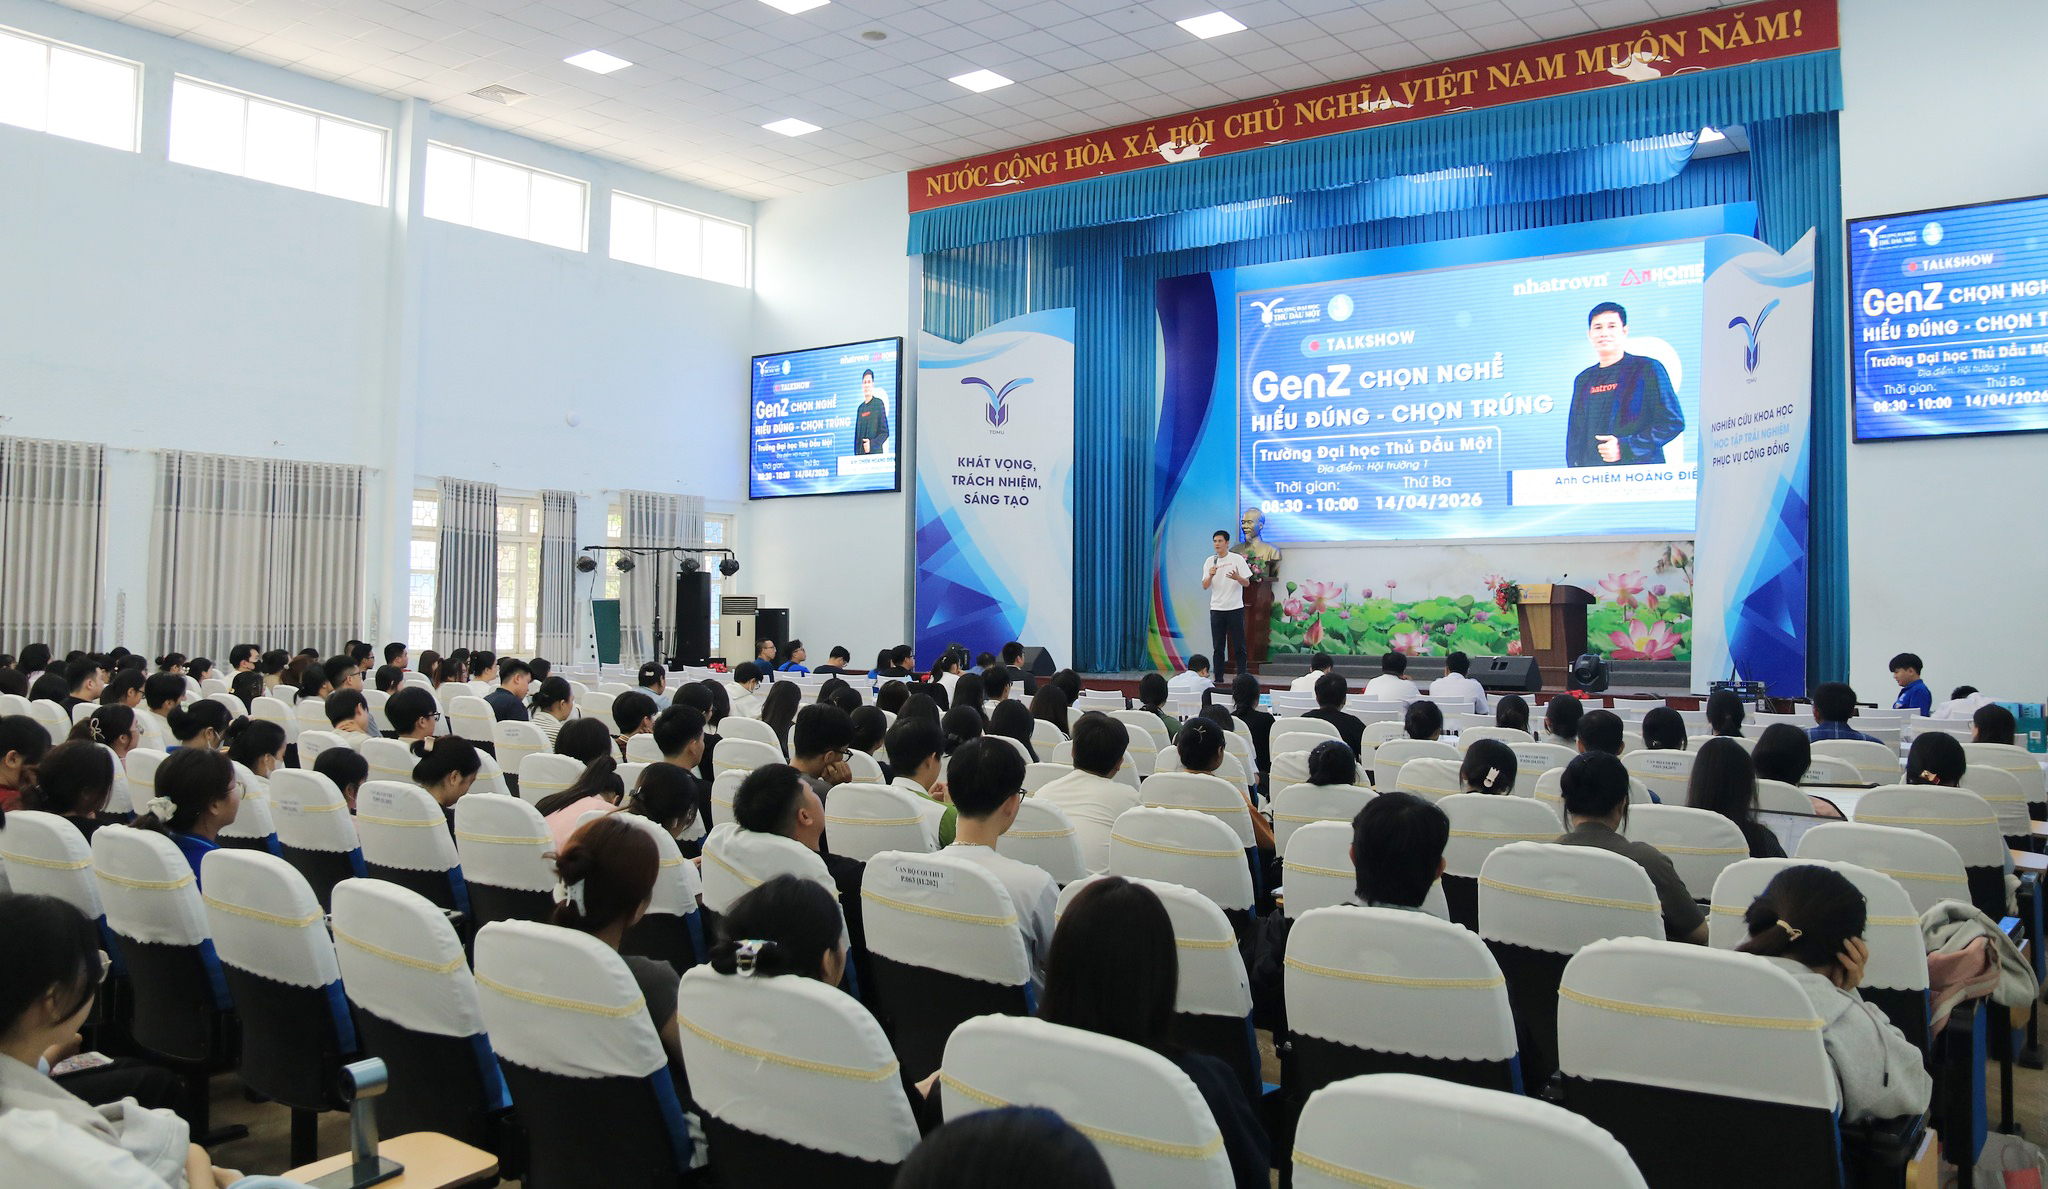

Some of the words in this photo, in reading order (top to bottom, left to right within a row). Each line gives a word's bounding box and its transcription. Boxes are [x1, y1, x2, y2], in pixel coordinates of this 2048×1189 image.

[926, 164, 988, 196] NƯỚC
[993, 151, 1058, 185] CỘNG
[1064, 140, 1116, 170] HÒA
[1123, 126, 1160, 156] XÃ
[1168, 116, 1215, 149] HỘI
[1224, 98, 1286, 139] CHỦ
[1294, 84, 1392, 126] NGHĨA
[1400, 67, 1479, 106] VIỆT
[1487, 52, 1567, 89] NAM
[1575, 28, 1687, 76] MUÔN
[1698, 9, 1804, 54] NĂM!
[1922, 253, 1994, 271] TALKSHOW
[1512, 273, 1609, 296] nhatrovn
[1862, 281, 1944, 317] GenZ
[1949, 283, 2005, 305] CHỌN
[1863, 318, 1901, 342] HIỂU
[1907, 318, 1959, 338] ĐÚNG
[1975, 313, 2033, 334] CHỌN
[1327, 330, 1415, 351] TALKSHOW
[1870, 354, 1914, 368] Trường
[1917, 352, 1940, 365] Đại
[1943, 350, 1968, 365] học
[1971, 346, 1995, 360] Thủ
[1999, 342, 2027, 358] Dầu
[2030, 343, 2048, 357] Mộ
[780, 381, 811, 392] TALKSHOW
[1252, 364, 1351, 403] GenZ
[1359, 366, 1429, 391] CHỌN
[1437, 351, 1504, 383] NGHỀ
[1986, 375, 2007, 388] Thứ
[2009, 376, 2026, 387] Ba
[1883, 382, 1907, 395] Thời
[1909, 382, 1936, 396] gian:
[1873, 399, 1908, 413] 08:30
[1918, 396, 1952, 410] 10:00
[1965, 390, 2048, 408] 14/04/2026
[755, 398, 789, 420] GenZ
[790, 400, 814, 415] CHỌN
[1251, 404, 1298, 432] HIỂU
[1305, 405, 1371, 429] ĐÚNG
[1391, 401, 1463, 426] CHỌN
[1470, 391, 1555, 418] TRÚNG
[1711, 417, 1736, 433] NGHIÊN
[1737, 414, 1752, 428] CỨU
[1753, 409, 1775, 424] KHOA
[1776, 403, 1794, 420] HỌC
[755, 420, 771, 436] HIỂU
[773, 420, 795, 434] ĐÚNG
[801, 419, 824, 433] CHỌN
[825, 416, 851, 429] TRÚNG
[1713, 436, 1729, 451] HỌC
[1761, 423, 1790, 440] NGHIỆM
[1259, 447, 1312, 463] Trường
[1317, 444, 1344, 460] Đại
[1349, 443, 1380, 460] học
[1385, 438, 1414, 456] Thủ
[1419, 435, 1454, 453] Dầu
[1460, 435, 1493, 454] Một
[1712, 453, 1731, 471] PHỤC
[1732, 452, 1742, 465] VỤ
[1743, 447, 1765, 463] CỘNG
[1767, 440, 1790, 456] ĐỒNG
[957, 455, 991, 468] KHÁT
[994, 458, 1037, 472] VỌNG,
[1317, 463, 1334, 475] Địa
[1336, 461, 1364, 473] điểm:
[1367, 461, 1384, 473] Hội
[1386, 460, 1420, 471] trường
[1424, 459, 1428, 468] 1
[951, 473, 994, 487] TRÁCH
[998, 474, 1042, 490] NHIỆM,
[1275, 480, 1302, 493] Thời
[1305, 480, 1340, 495] gian:
[1402, 475, 1428, 488] Thứ
[1432, 475, 1452, 487] Ba
[1555, 476, 1578, 485] Anh
[964, 491, 1000, 505] SÁNG
[1004, 495, 1030, 508] TẠO
[1261, 498, 1303, 514] 08:30
[1316, 497, 1359, 512] 10:00
[1375, 492, 1483, 511] 14/04/2026
